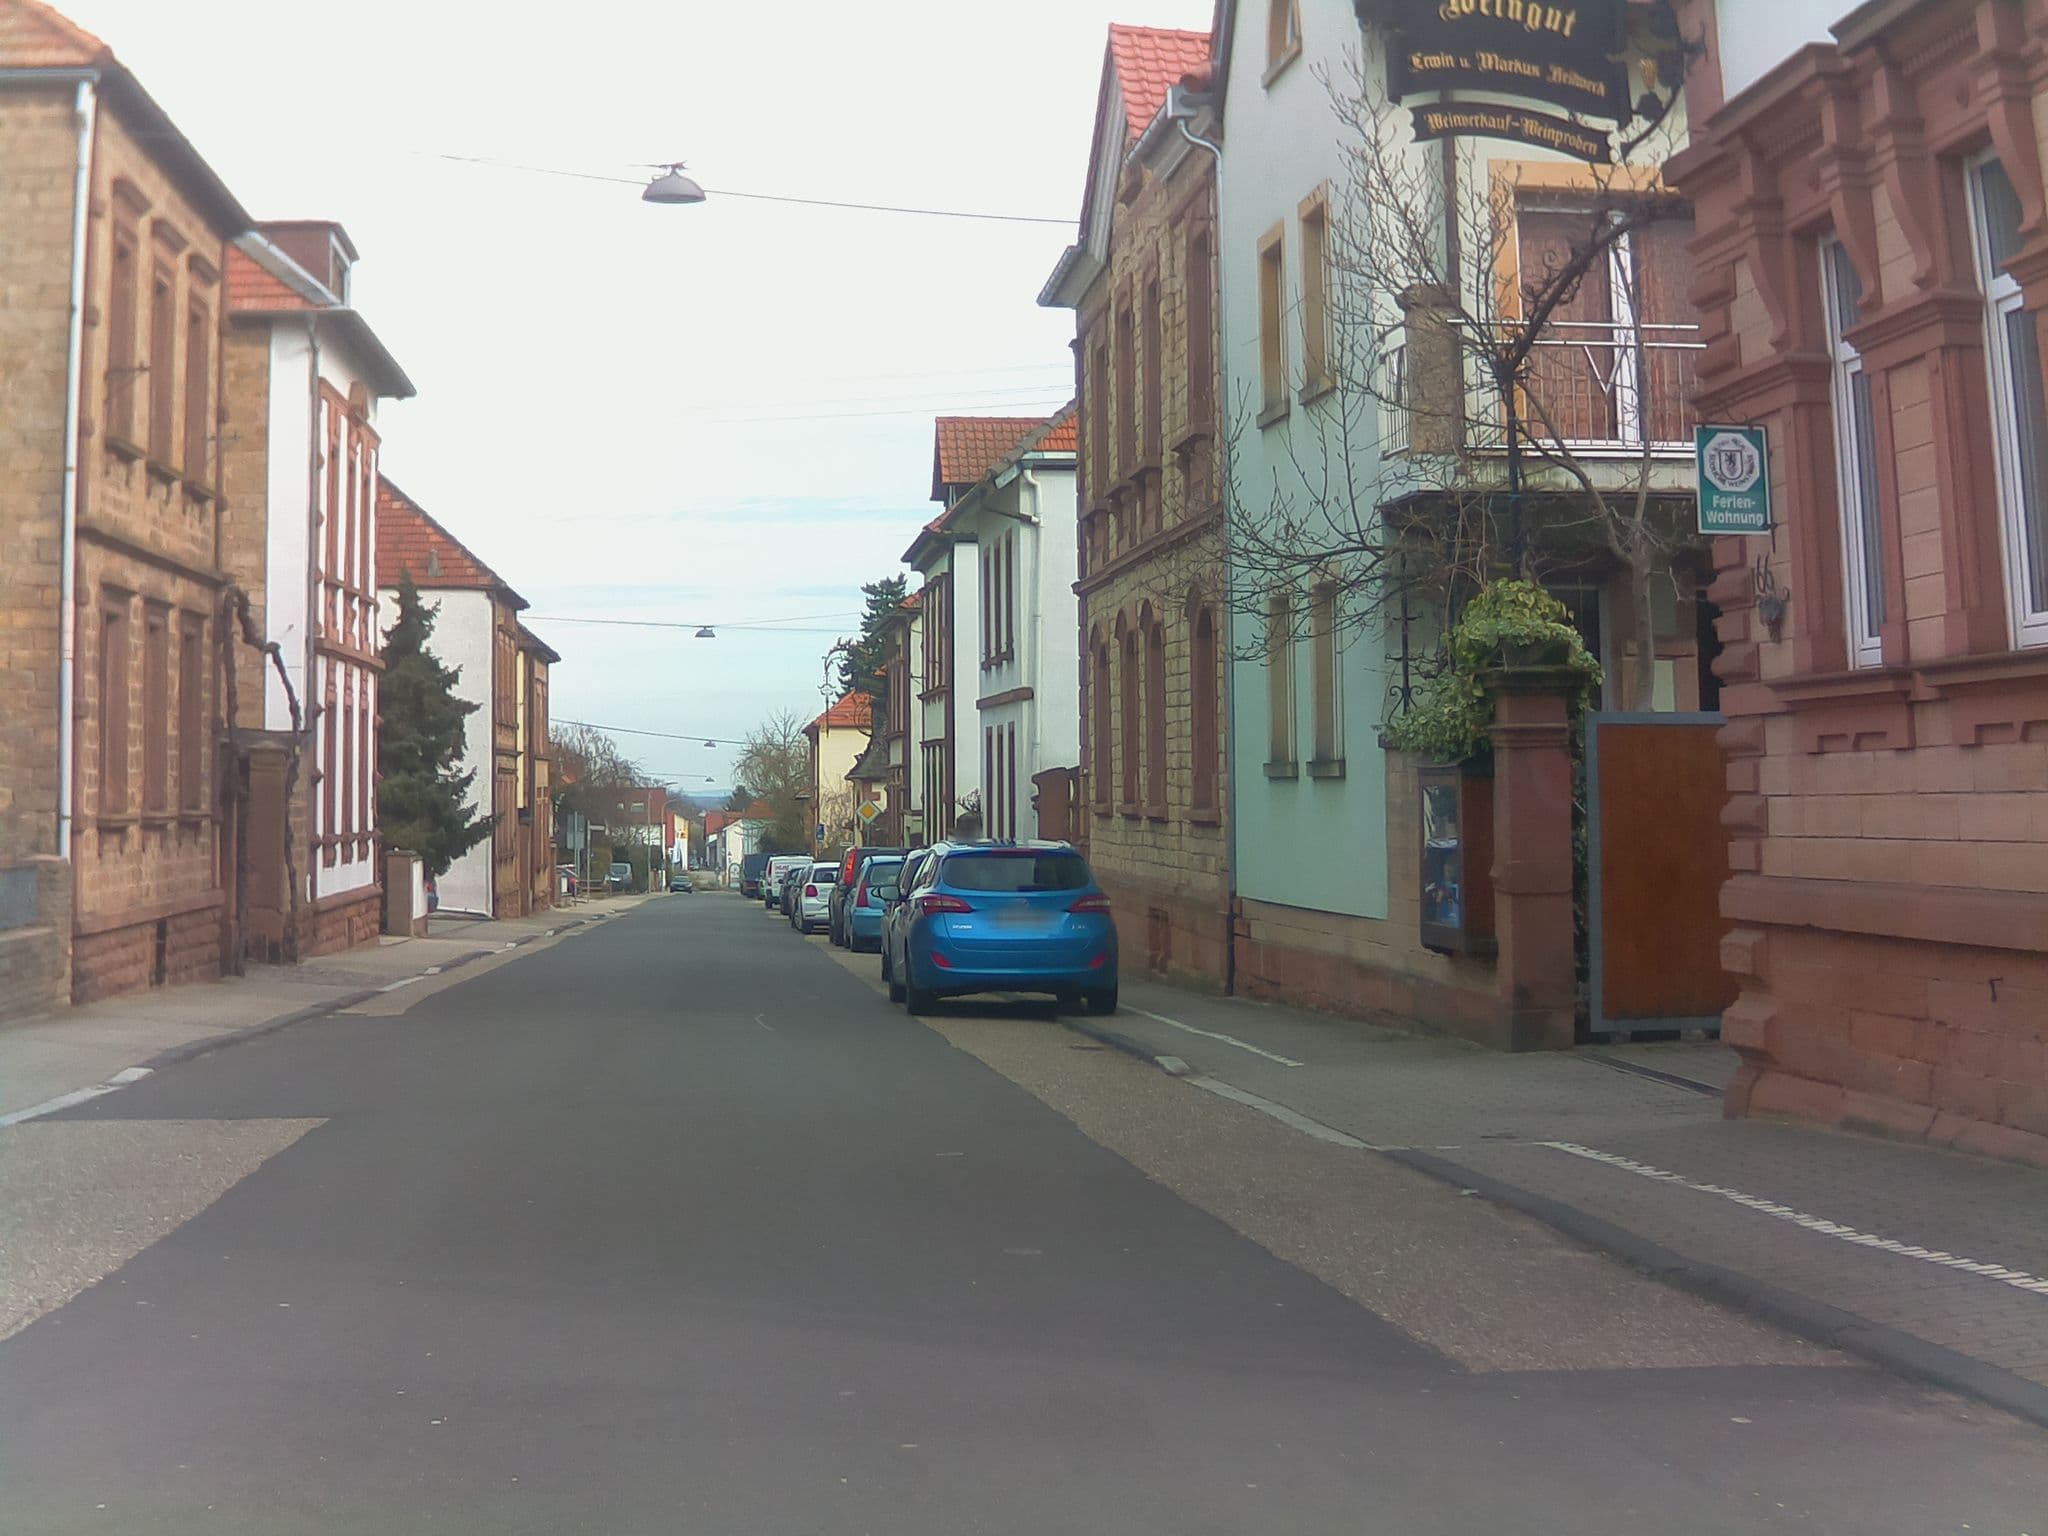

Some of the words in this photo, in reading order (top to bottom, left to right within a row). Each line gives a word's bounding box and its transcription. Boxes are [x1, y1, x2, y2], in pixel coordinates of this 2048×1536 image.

[1476, 51, 1541, 78] Markus
[1712, 494, 1757, 509] Ferien-
[1706, 511, 1764, 527] Wohnung
